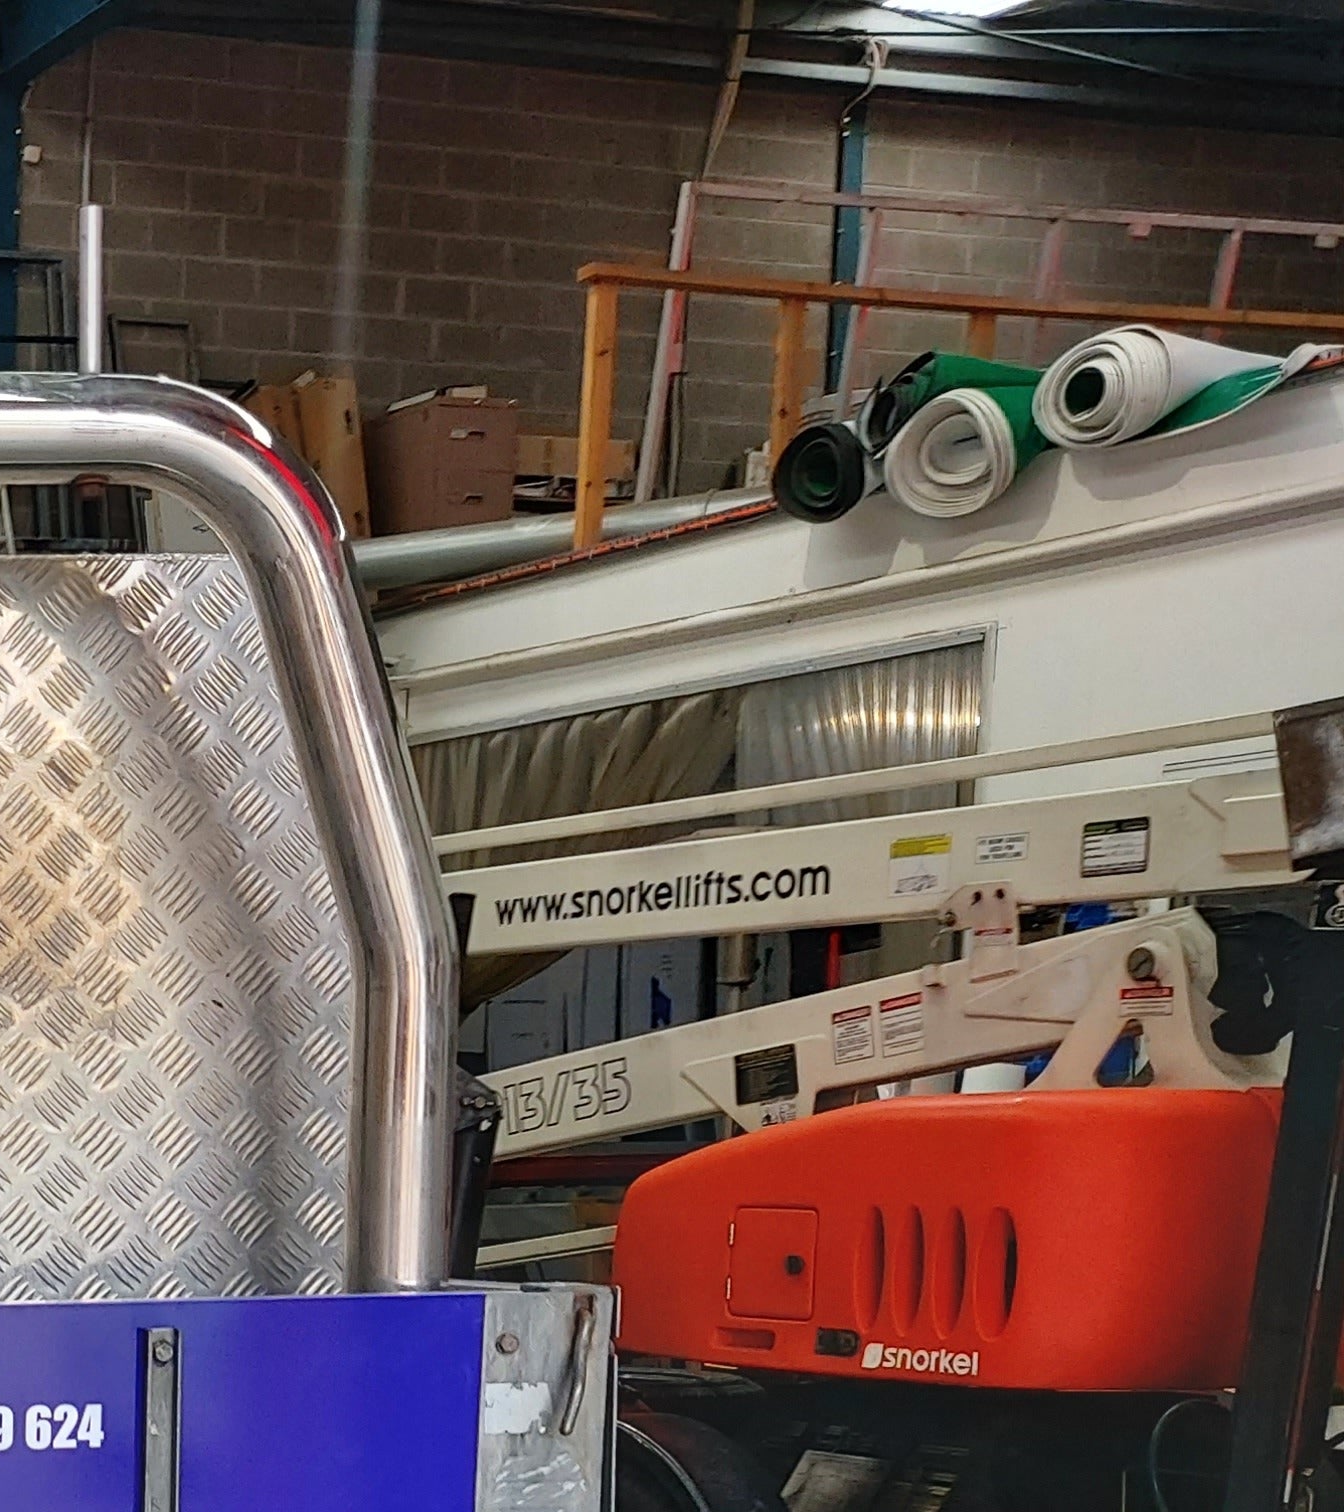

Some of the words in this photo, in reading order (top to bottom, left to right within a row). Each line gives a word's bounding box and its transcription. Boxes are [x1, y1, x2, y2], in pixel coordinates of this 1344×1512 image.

[495, 864, 831, 927] www.snorkellifts.com
[500, 1057, 632, 1136] 13/35
[882, 1347, 979, 1376] snorkel
[25, 1403, 105, 1451] 624
